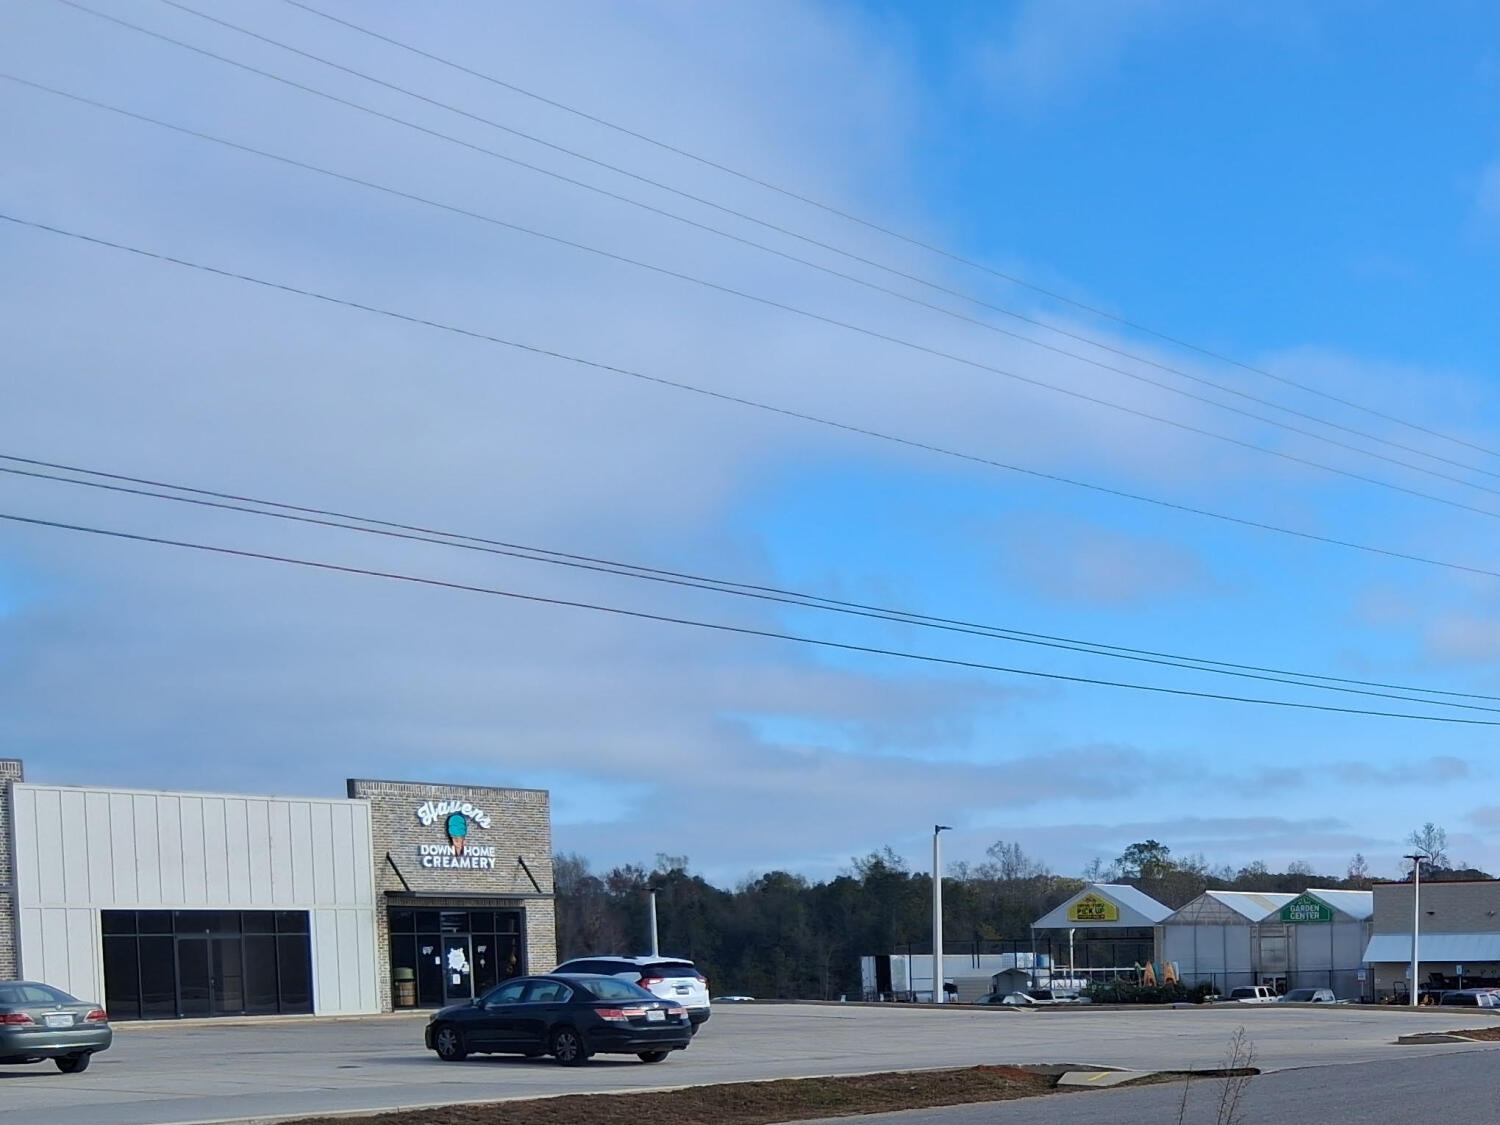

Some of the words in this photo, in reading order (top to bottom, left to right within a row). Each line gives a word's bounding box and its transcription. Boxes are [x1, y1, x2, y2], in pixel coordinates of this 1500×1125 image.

[420, 844, 456, 856] DOWN
[463, 846, 496, 857] HOME
[422, 855, 497, 869] CREAMERY
[1290, 904, 1320, 912] GARDEN
[1290, 911, 1320, 920] CENTER
